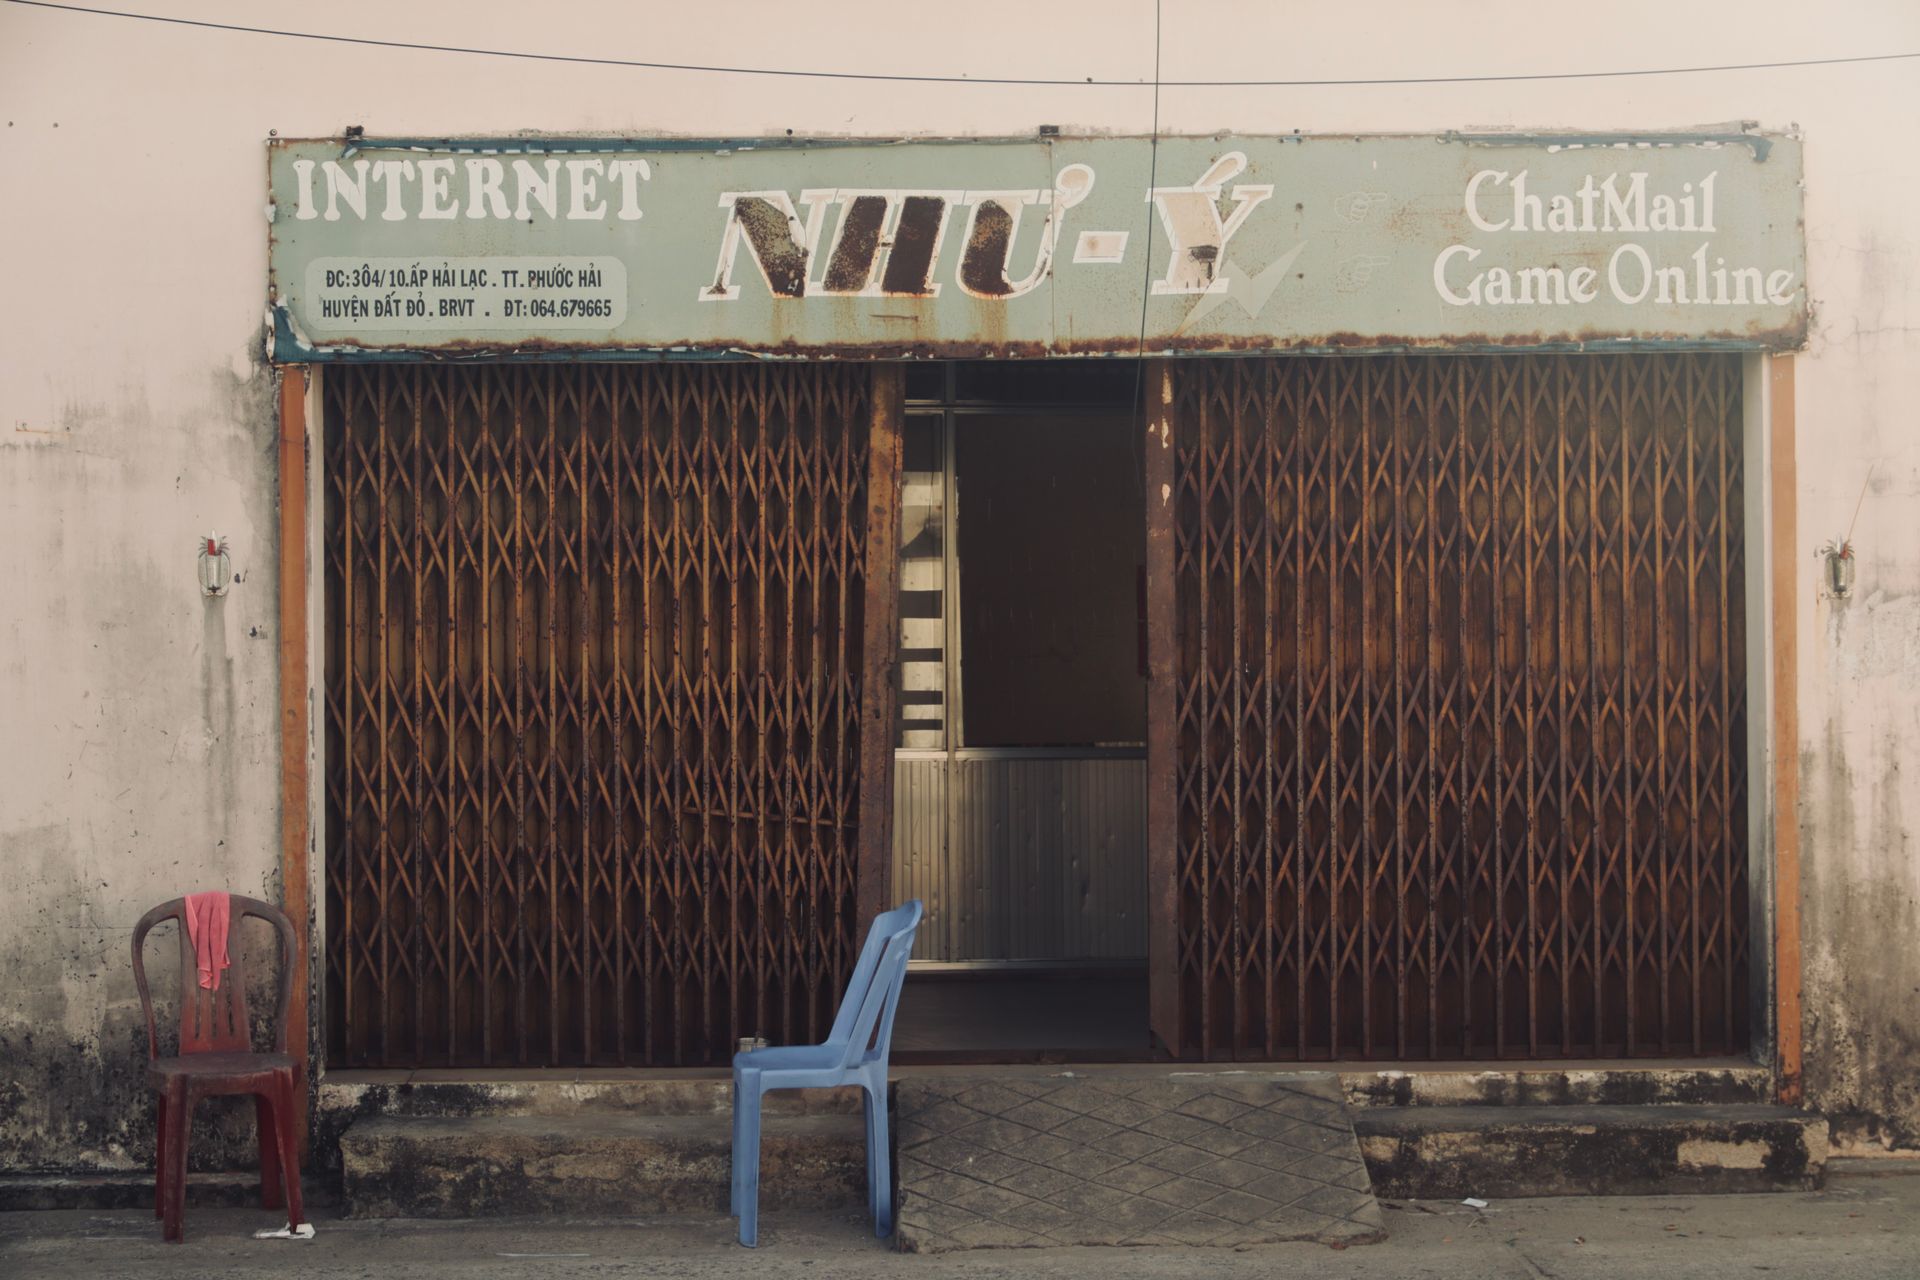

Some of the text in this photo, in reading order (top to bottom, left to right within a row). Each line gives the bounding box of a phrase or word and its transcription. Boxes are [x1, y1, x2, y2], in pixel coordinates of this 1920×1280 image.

[293, 158, 651, 221] INTERNET
[432, 262, 456, 288] HẢI
[461, 269, 488, 291] LẠC
[579, 262, 602, 288] HẢI
[1433, 241, 1796, 307] Game Online
[322, 295, 369, 323] HUYỆN
[374, 291, 402, 318] ĐẤT
[439, 299, 475, 318] BRVT
